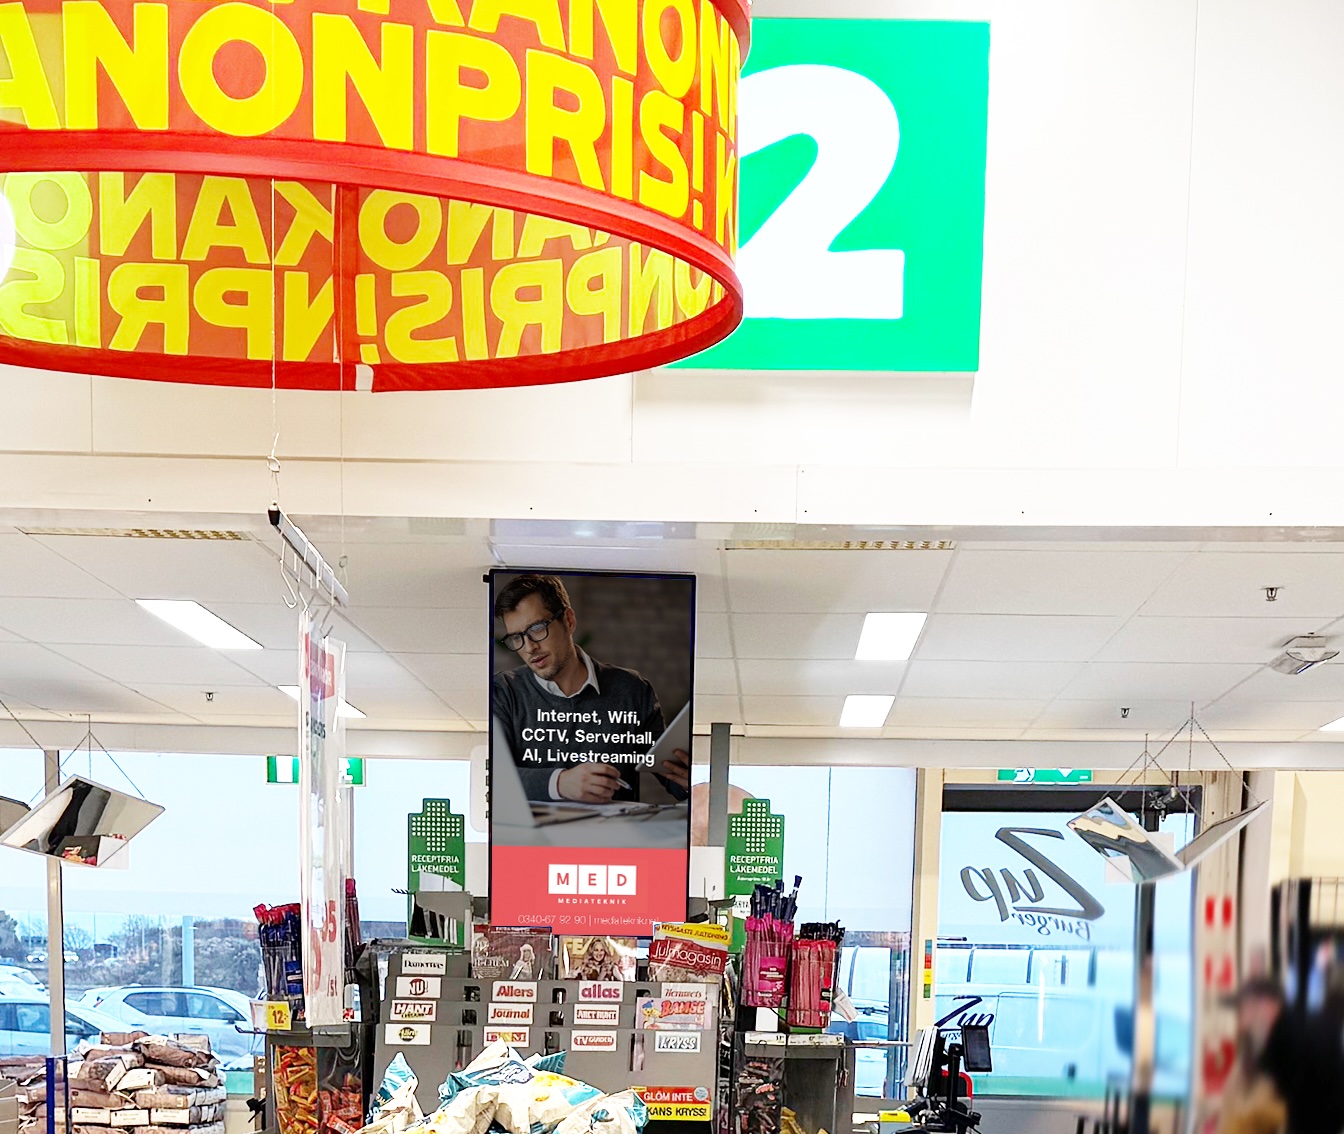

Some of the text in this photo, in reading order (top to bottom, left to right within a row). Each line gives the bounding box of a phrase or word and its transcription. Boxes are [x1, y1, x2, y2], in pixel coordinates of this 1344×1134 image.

[739, 63, 906, 320] 2
[536, 709, 641, 726] Internet, Wifi,
[521, 728, 656, 747] CCTV, Serverhall,
[522, 748, 655, 767] AI, Livestreaming
[411, 854, 460, 864] RECEPTFRIA
[730, 854, 778, 864] RECEPTFRIA
[411, 863, 459, 874] LÄKEMEDEL
[730, 864, 778, 874] LÄKEMEDEL
[556, 872, 628, 886] MED
[560, 914, 571, 925] 92
[574, 914, 587, 925] 90
[496, 985, 533, 998] Allers
[581, 985, 620, 999] allas
[490, 1007, 530, 1019] Journal
[660, 1000, 705, 1018] BAMSE
[659, 1035, 697, 1049] KRYSS
[644, 1091, 693, 1102] GLÖM INTE
[675, 1107, 707, 1117] KRYSS!
